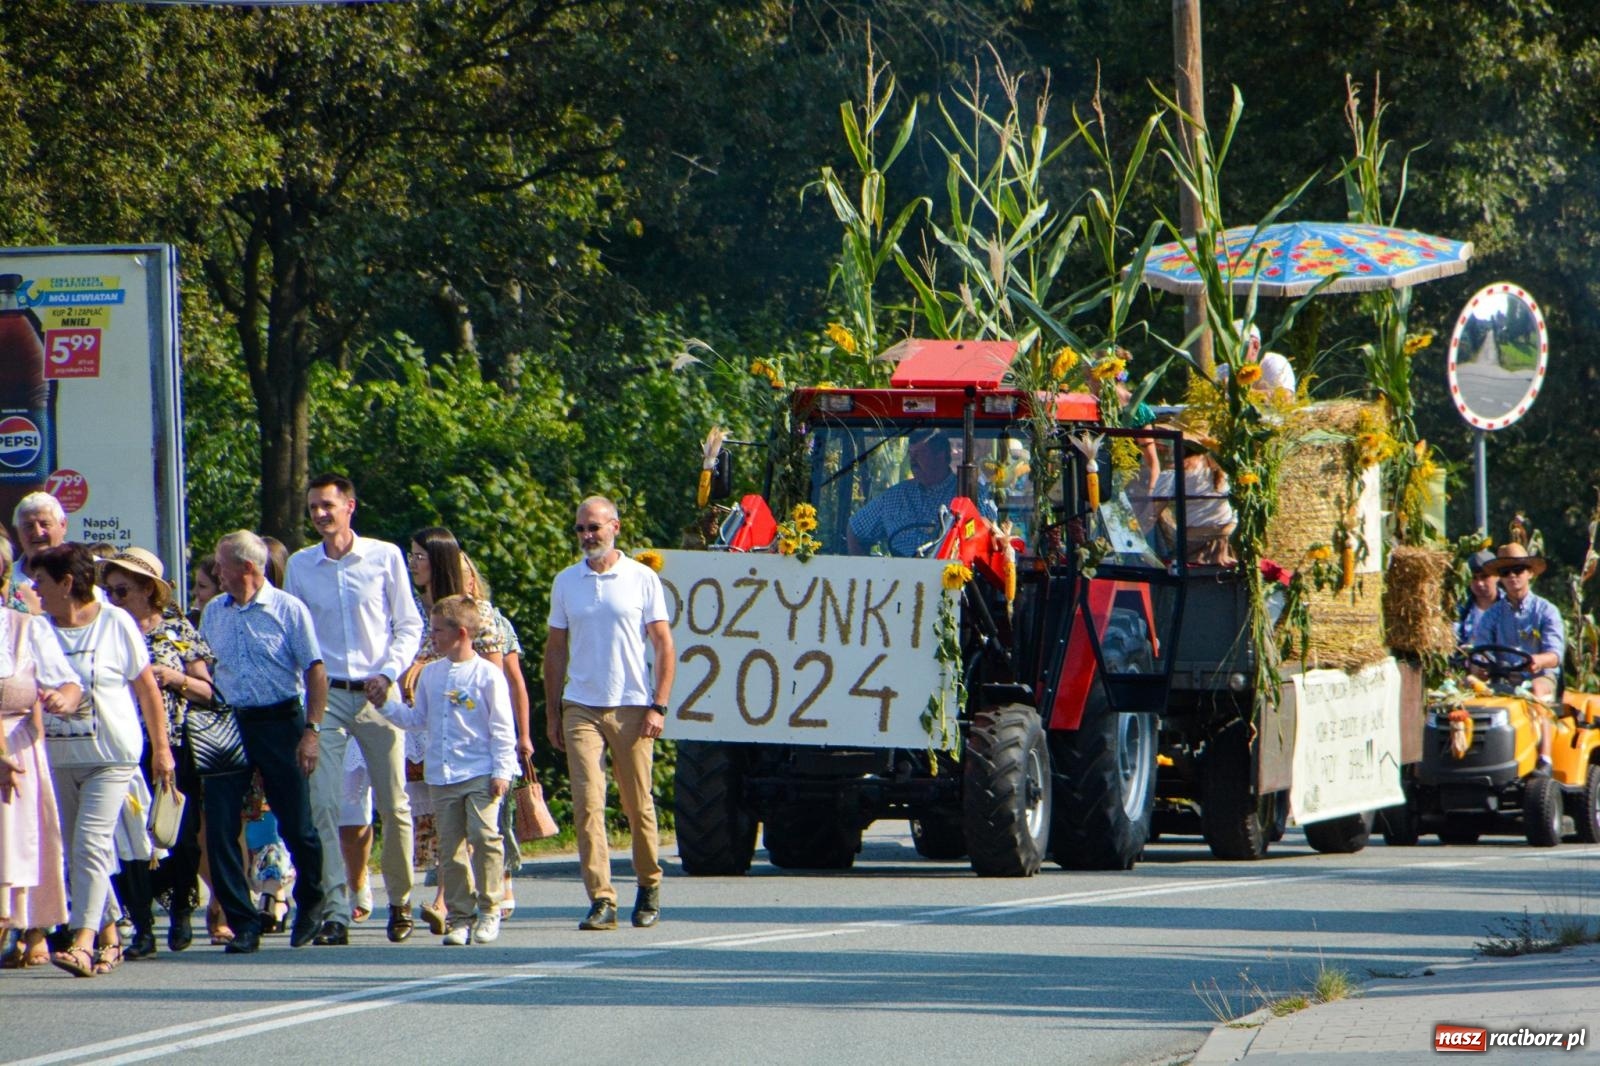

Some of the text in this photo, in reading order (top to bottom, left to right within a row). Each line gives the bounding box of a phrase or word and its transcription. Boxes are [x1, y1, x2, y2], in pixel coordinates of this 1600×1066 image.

[49, 292, 118, 302] MÓJ LEWIATAN
[67, 307, 73, 317] 2
[61, 318, 91, 327] MNIEJ
[83, 517, 119, 530] Napój
[83, 530, 116, 541] Pepsi
[676, 645, 898, 732] 2024
